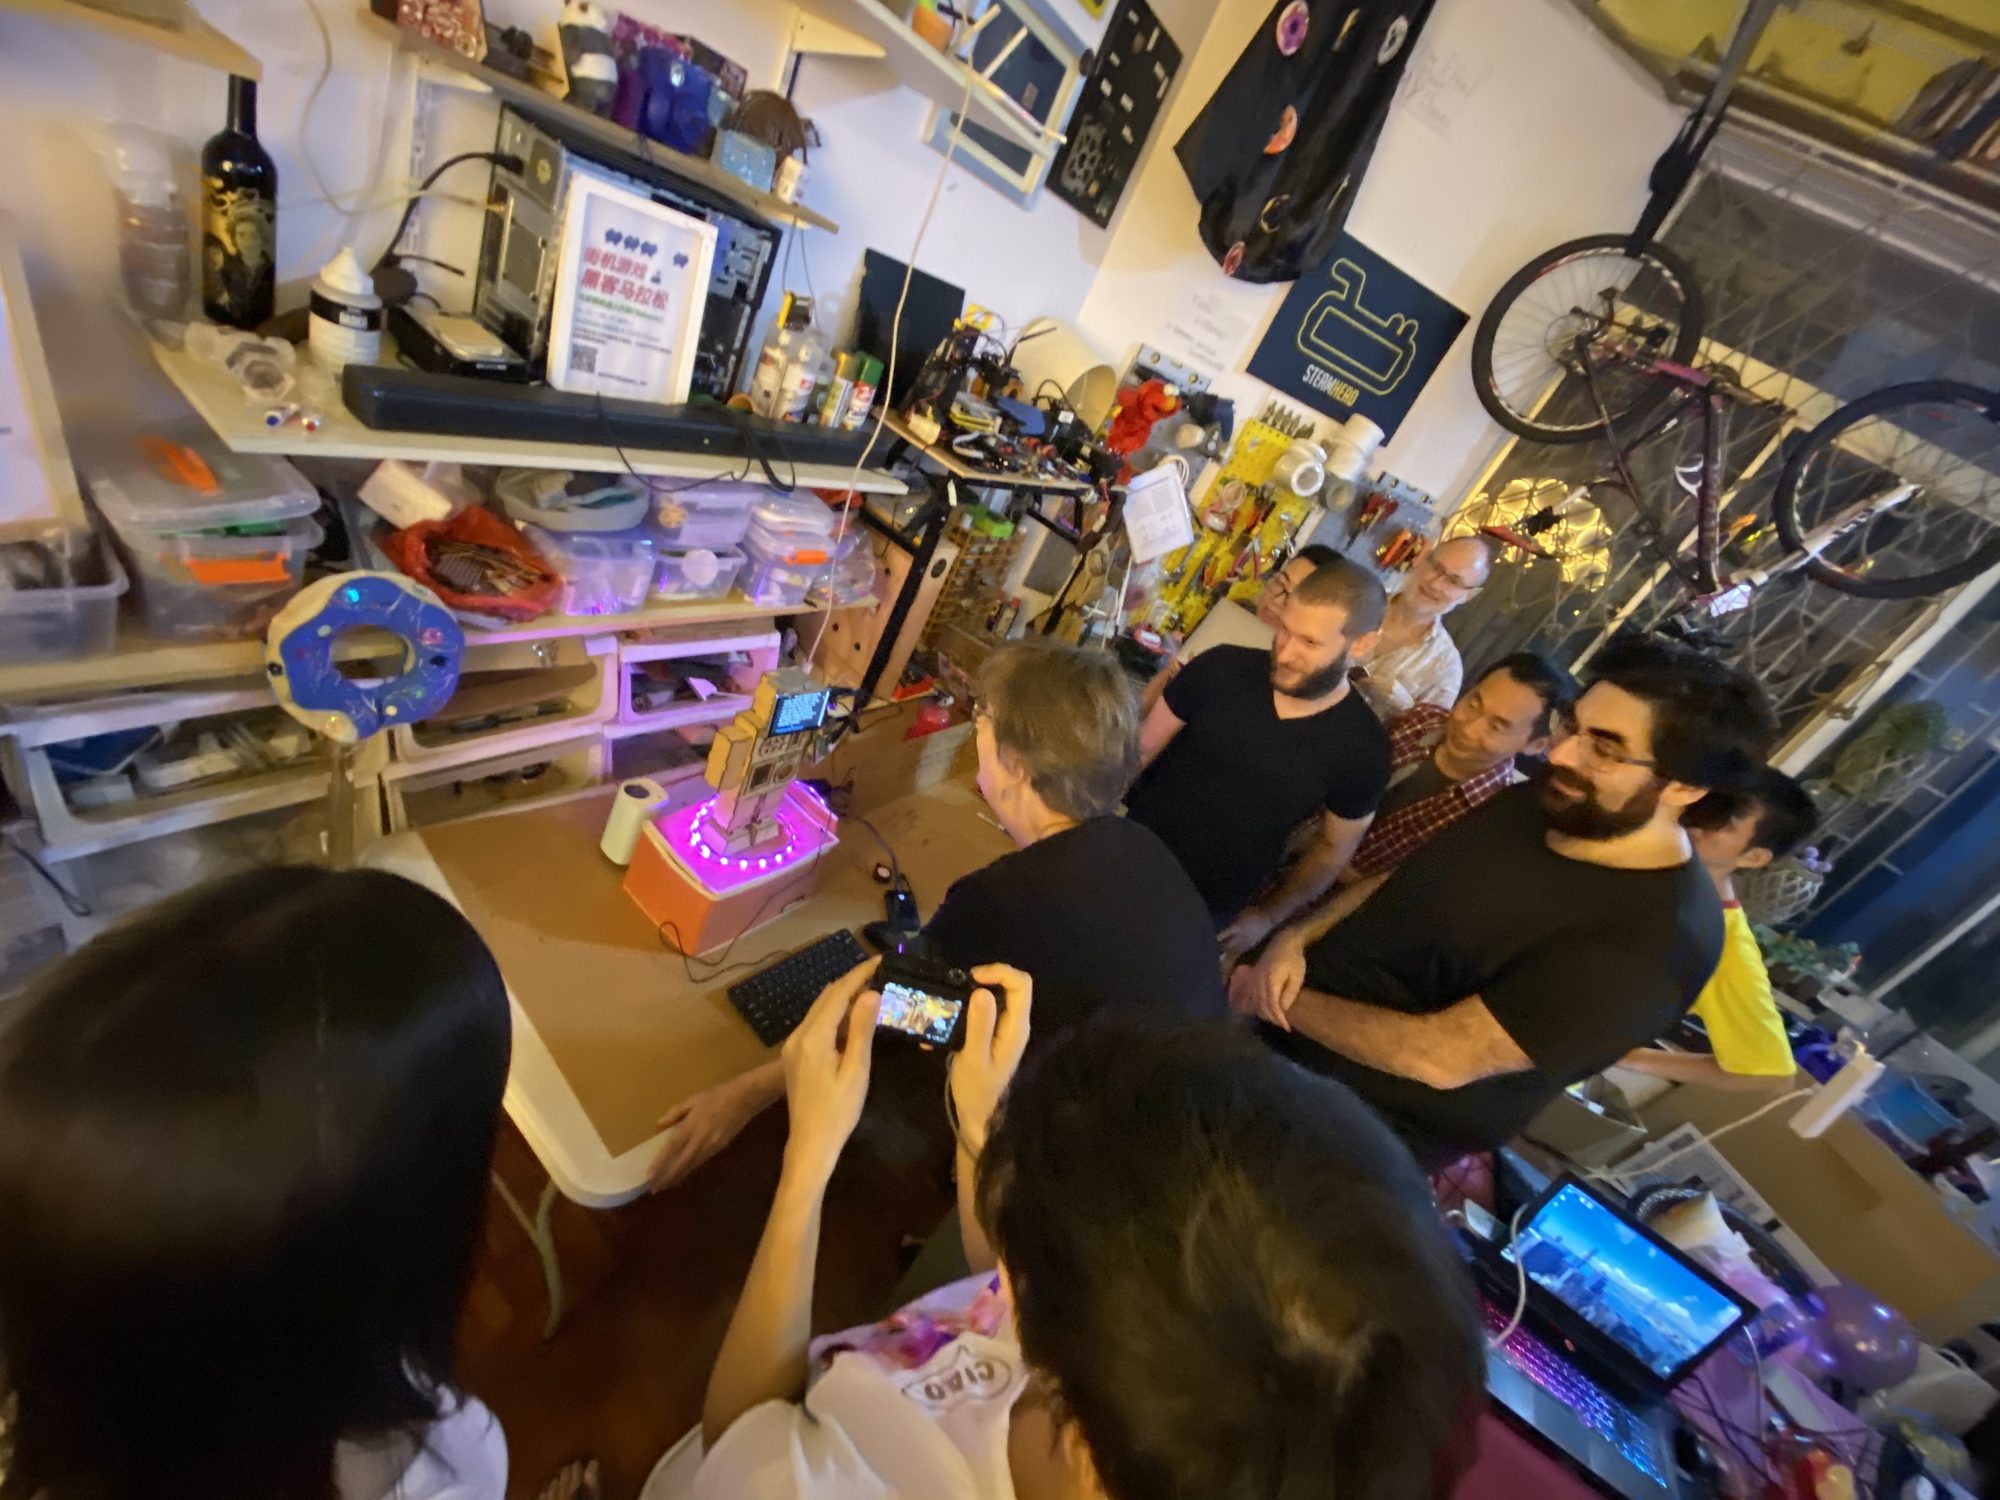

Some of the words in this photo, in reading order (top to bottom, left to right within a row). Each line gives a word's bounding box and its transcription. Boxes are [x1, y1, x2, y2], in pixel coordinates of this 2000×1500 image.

[581, 269, 669, 310] 黑客马拉松
[1302, 364, 1359, 406] STEAMHEAD
[925, 1361, 994, 1400] CIAO
